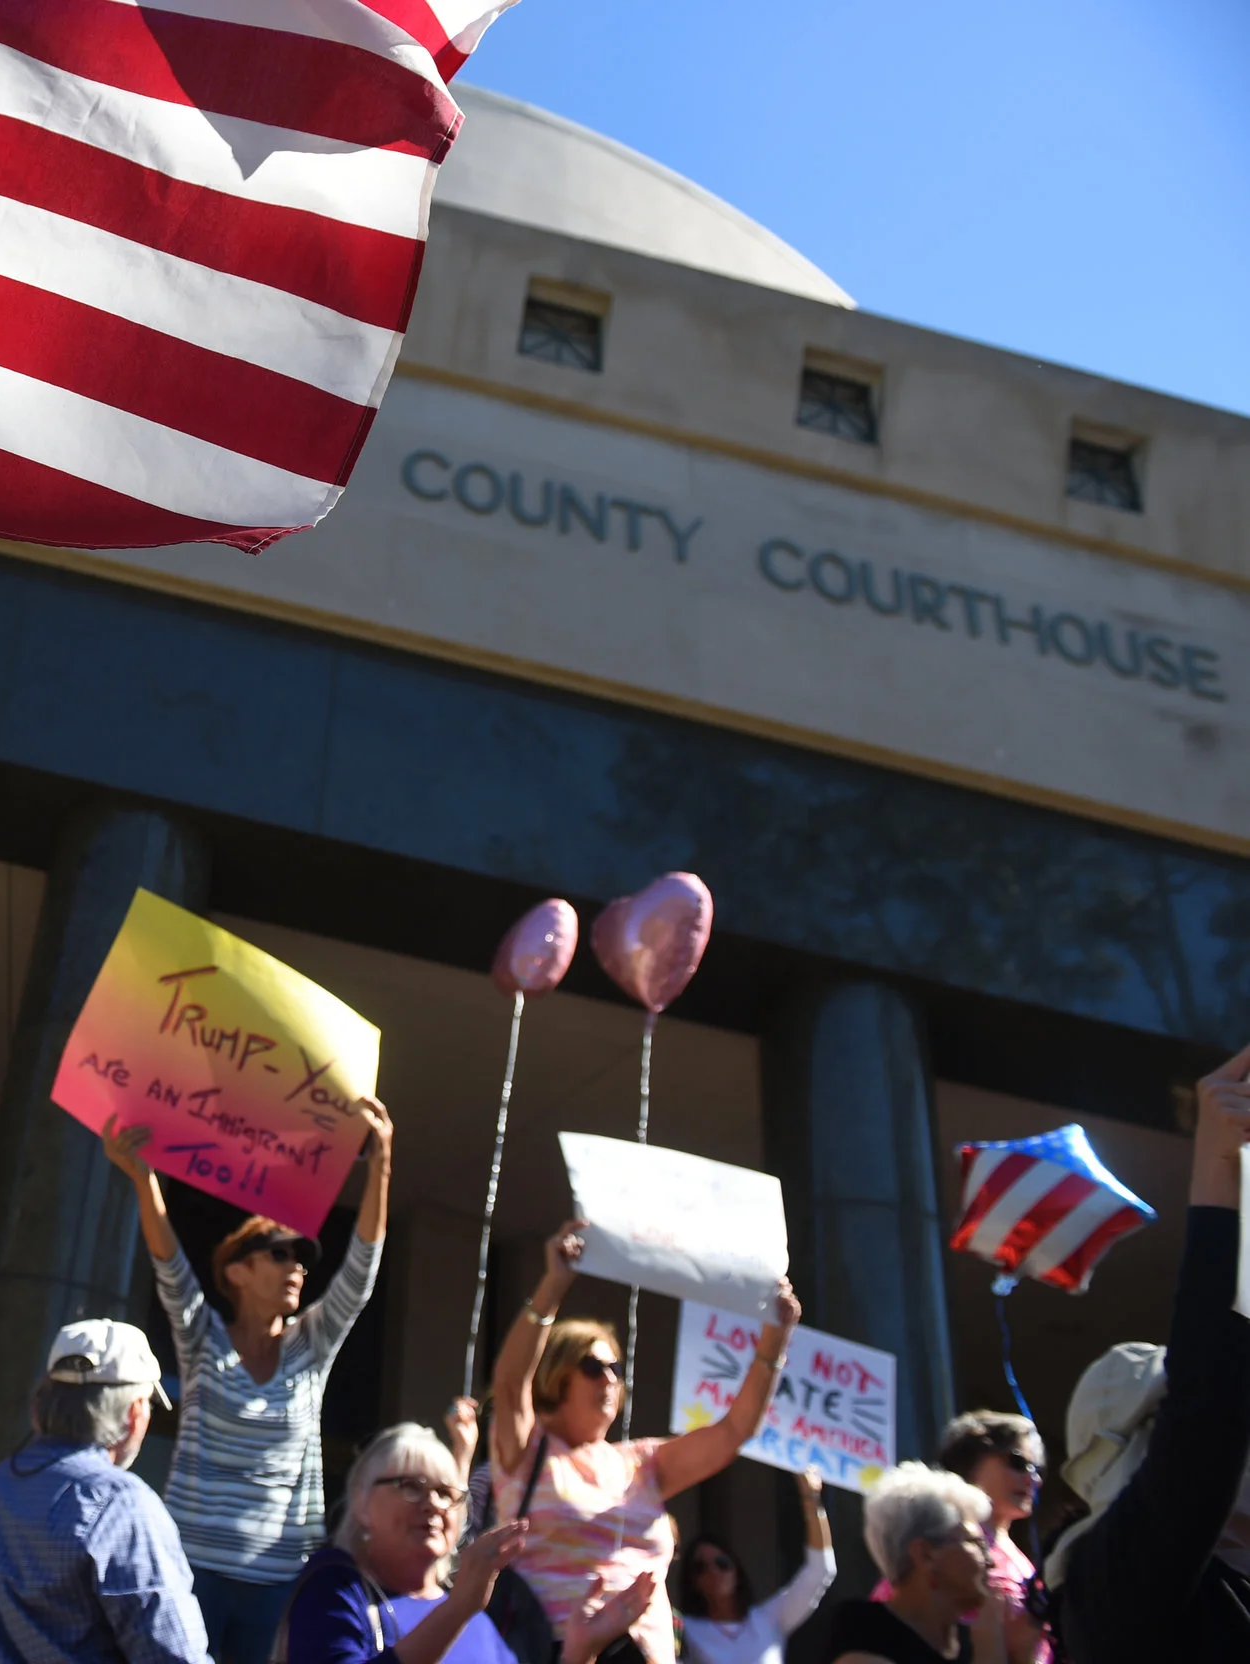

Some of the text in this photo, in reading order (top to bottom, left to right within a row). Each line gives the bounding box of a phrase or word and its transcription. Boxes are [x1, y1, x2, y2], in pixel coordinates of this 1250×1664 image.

[401, 449, 1227, 703] COUNTY COURTHOUSE
[146, 1079, 181, 1108] AN
[810, 1349, 886, 1395] NOT
[774, 1375, 843, 1422] ATE
[747, 1427, 864, 1479] REAT
